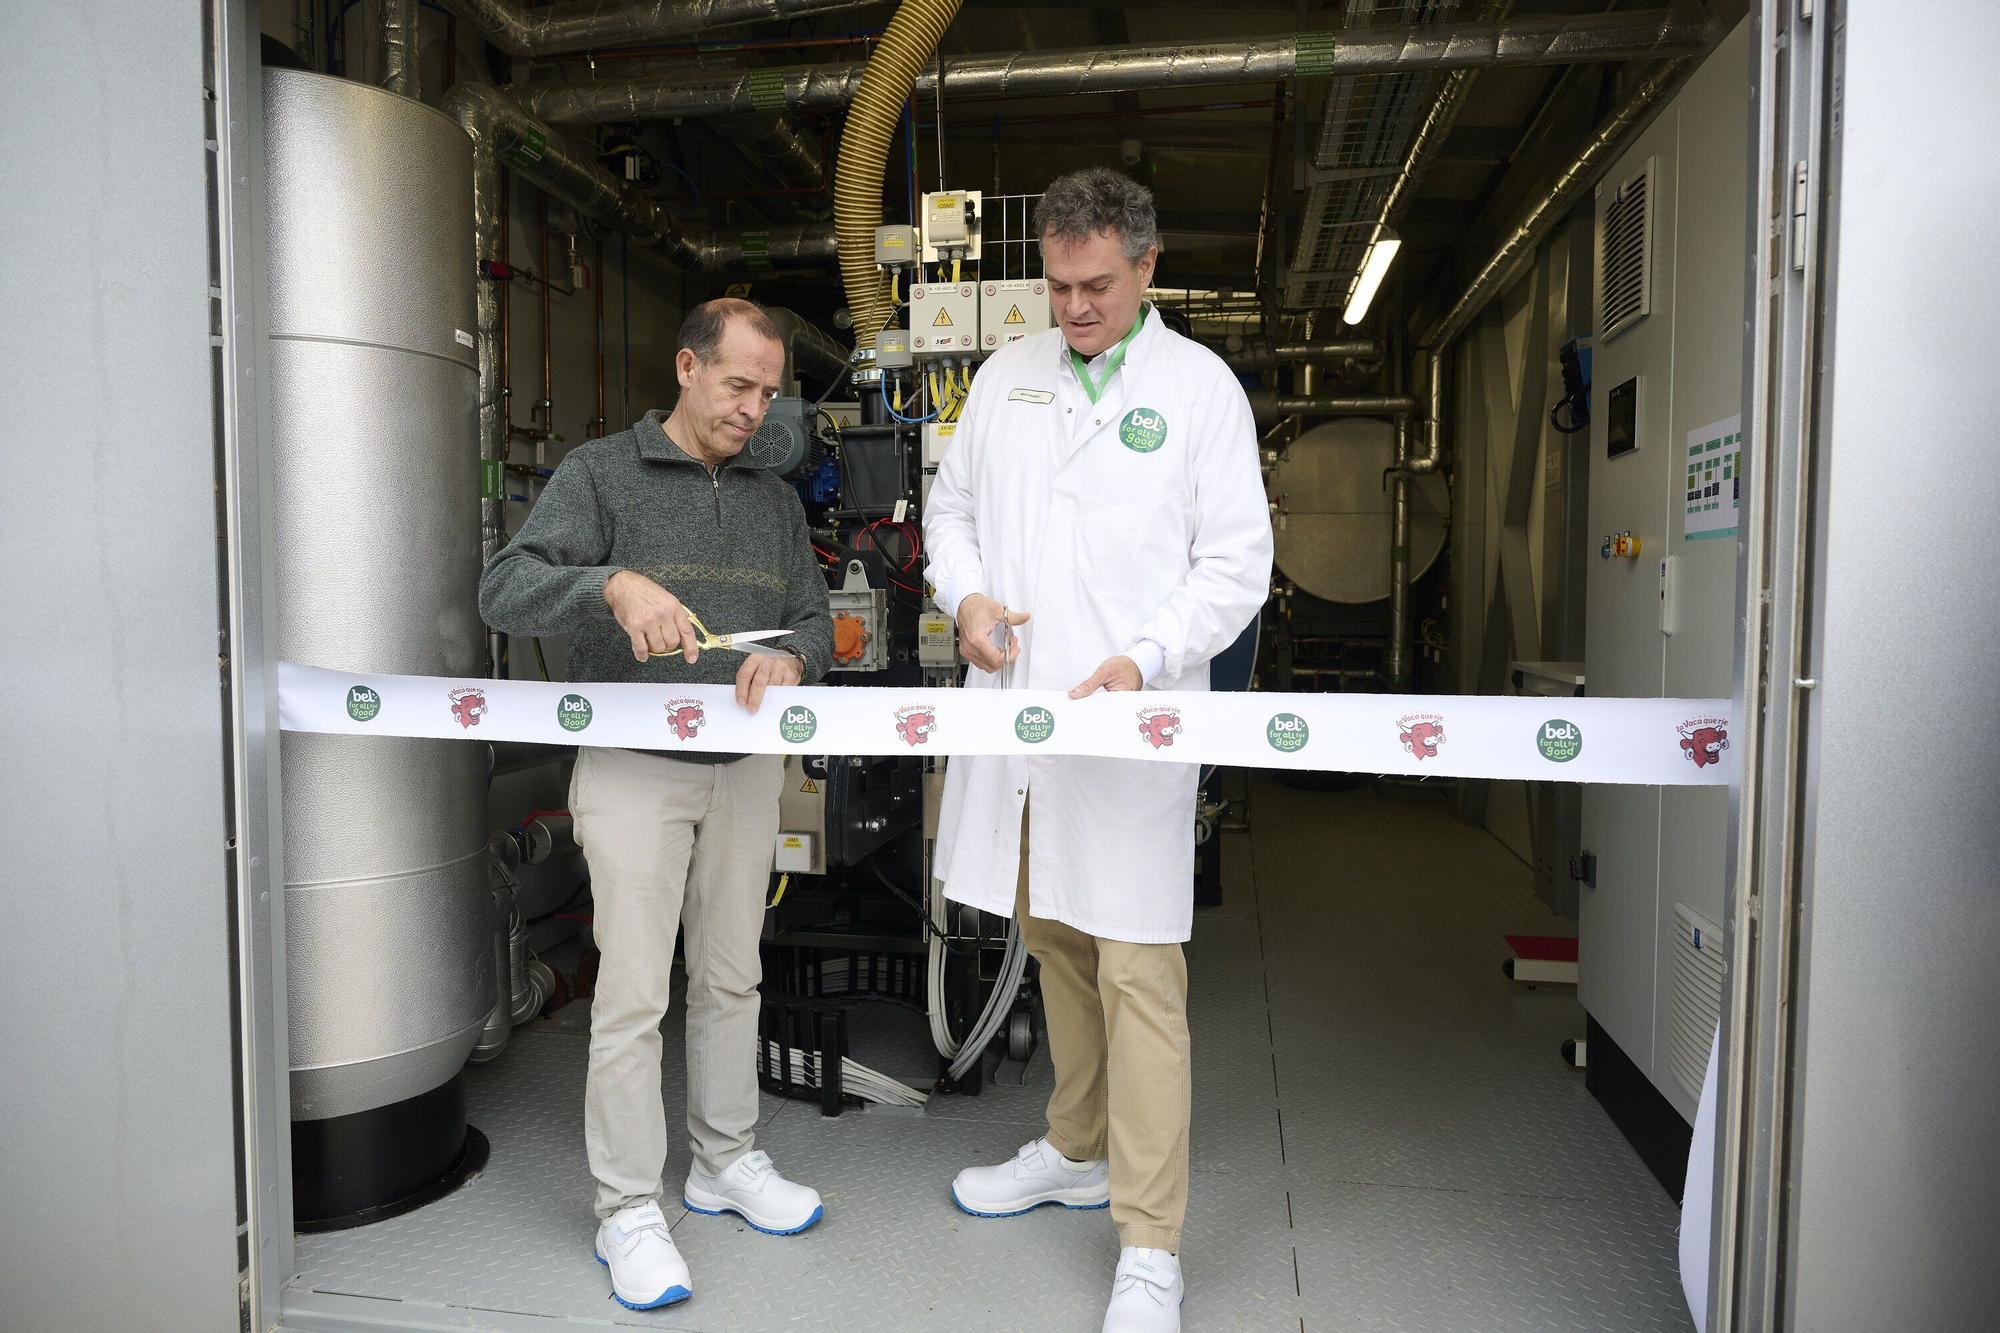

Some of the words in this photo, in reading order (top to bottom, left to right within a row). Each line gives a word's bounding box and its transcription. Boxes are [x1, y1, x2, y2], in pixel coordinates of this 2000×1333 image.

[1131, 410, 1160, 432] bel
[1123, 423, 1136, 432] for
[1137, 429, 1150, 439] all
[1125, 433, 1156, 448] good
[352, 689, 376, 702] bel
[350, 701, 359, 709] for
[564, 697, 587, 712] bel
[899, 705, 914, 713] Vaca
[352, 708, 374, 716] good
[787, 710, 811, 723] bel
[1023, 710, 1048, 723] bel
[564, 718, 586, 726] good
[1401, 714, 1419, 723] Vaca
[1274, 717, 1301, 731] bel
[1683, 719, 1702, 728] Vaca
[786, 731, 810, 739] good
[1022, 730, 1047, 738] good
[1270, 730, 1280, 738] for
[1282, 731, 1295, 739] all
[1545, 723, 1574, 739] bel
[1275, 738, 1301, 746] good
[1540, 738, 1553, 747] for
[1554, 740, 1567, 748] all
[1546, 747, 1574, 756] good
